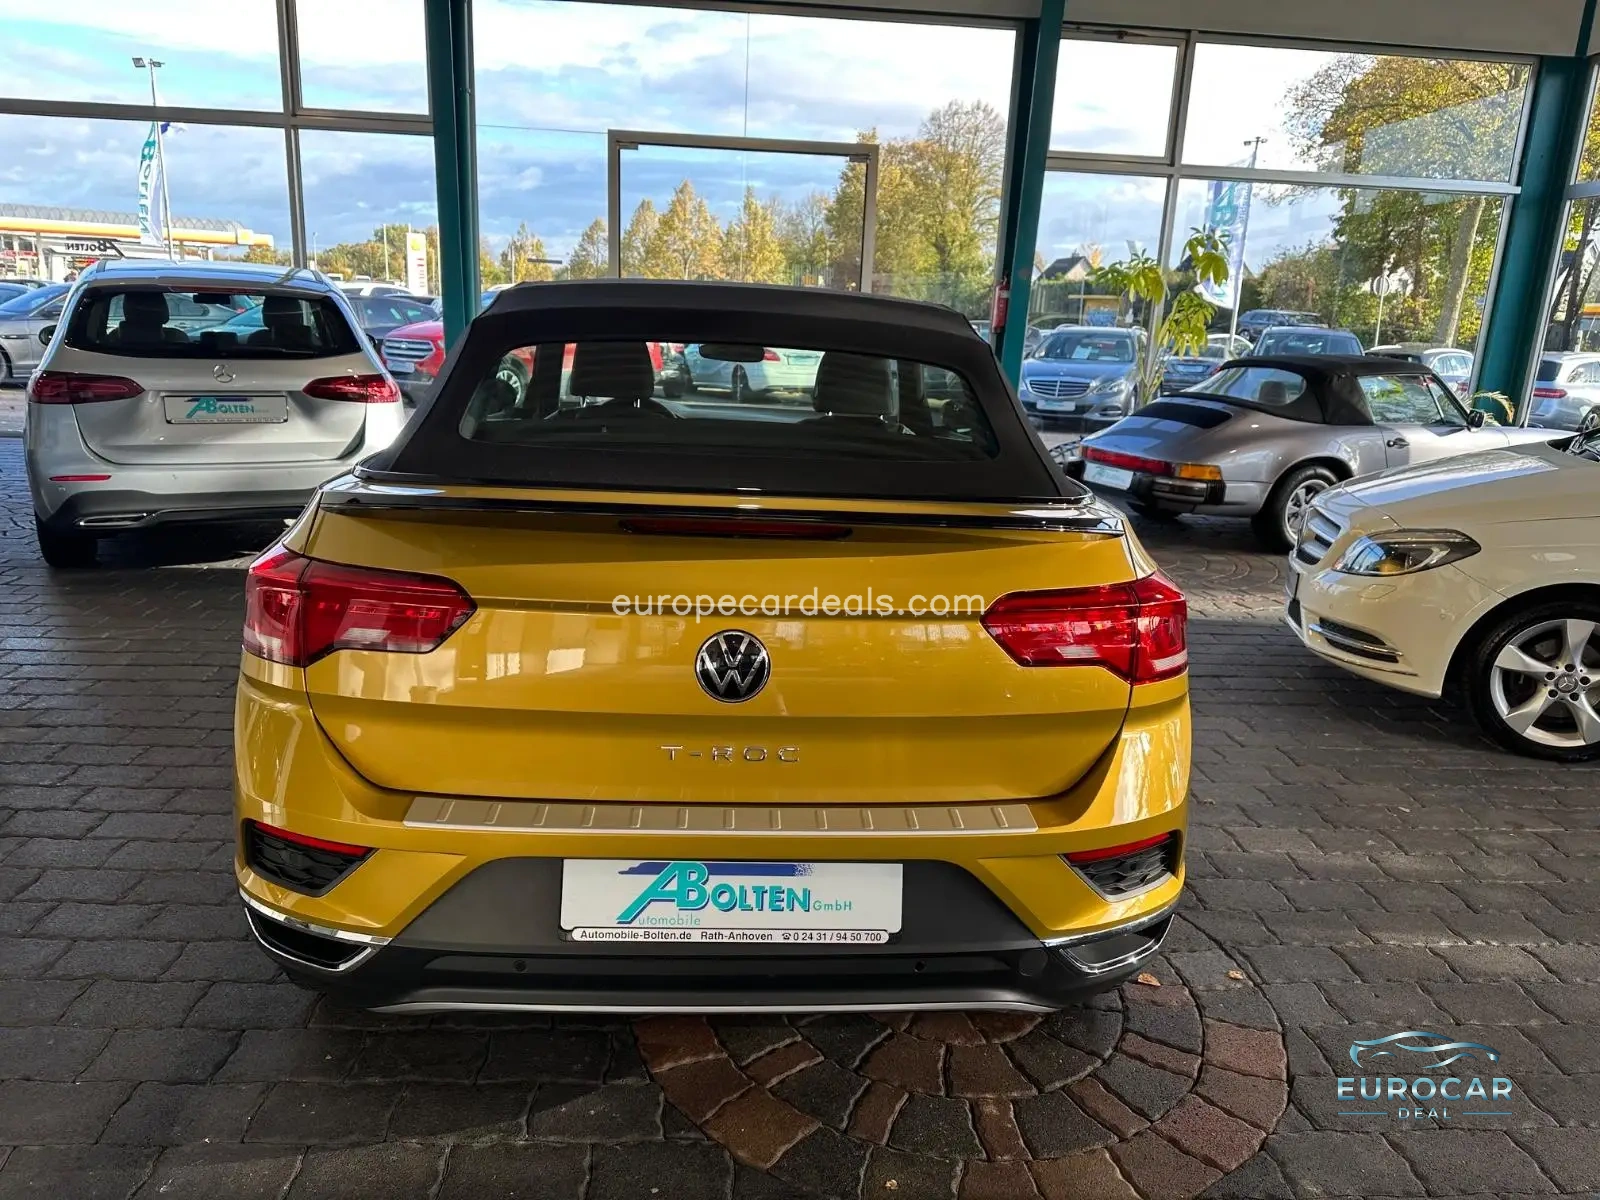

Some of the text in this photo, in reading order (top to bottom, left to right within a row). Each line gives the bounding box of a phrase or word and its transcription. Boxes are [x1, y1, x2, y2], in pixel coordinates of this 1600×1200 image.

[660, 744, 801, 763] T-ROC
[812, 899, 853, 912] GmbH
[580, 930, 692, 941] Automobile-Bolten.de
[700, 931, 773, 942] Rath-Anhoven
[864, 932, 882, 942] 700
